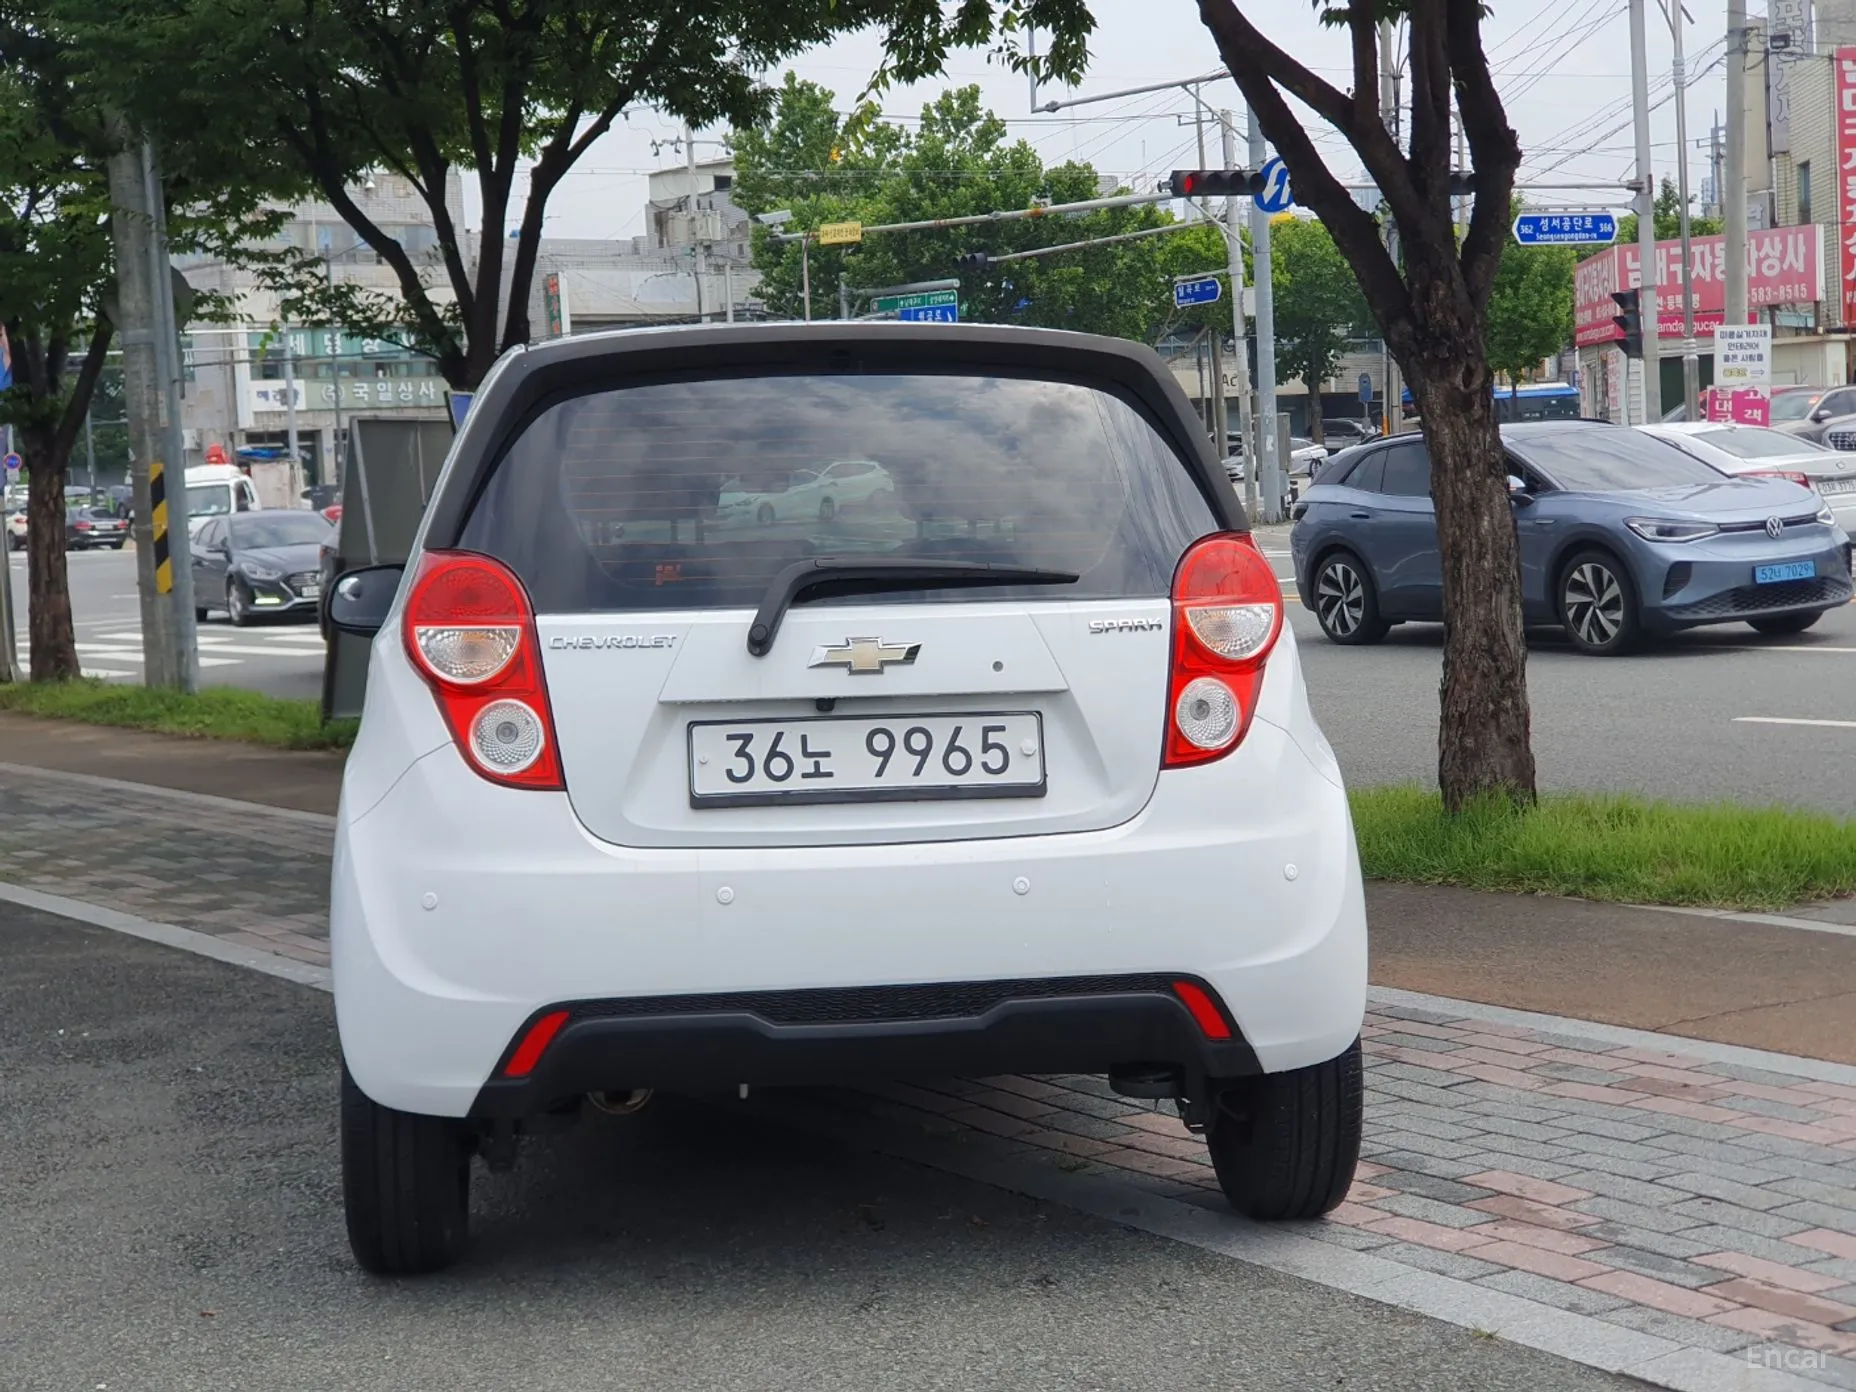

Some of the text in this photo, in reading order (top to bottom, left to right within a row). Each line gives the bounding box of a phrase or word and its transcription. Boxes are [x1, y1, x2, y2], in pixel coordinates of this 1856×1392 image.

[1539, 216, 1594, 232] 성서공단로
[352, 381, 436, 400] 국일상사
[1088, 617, 1164, 635] SPARK
[549, 634, 677, 650] CHEVROLET
[725, 724, 1011, 784] 36노 9965
